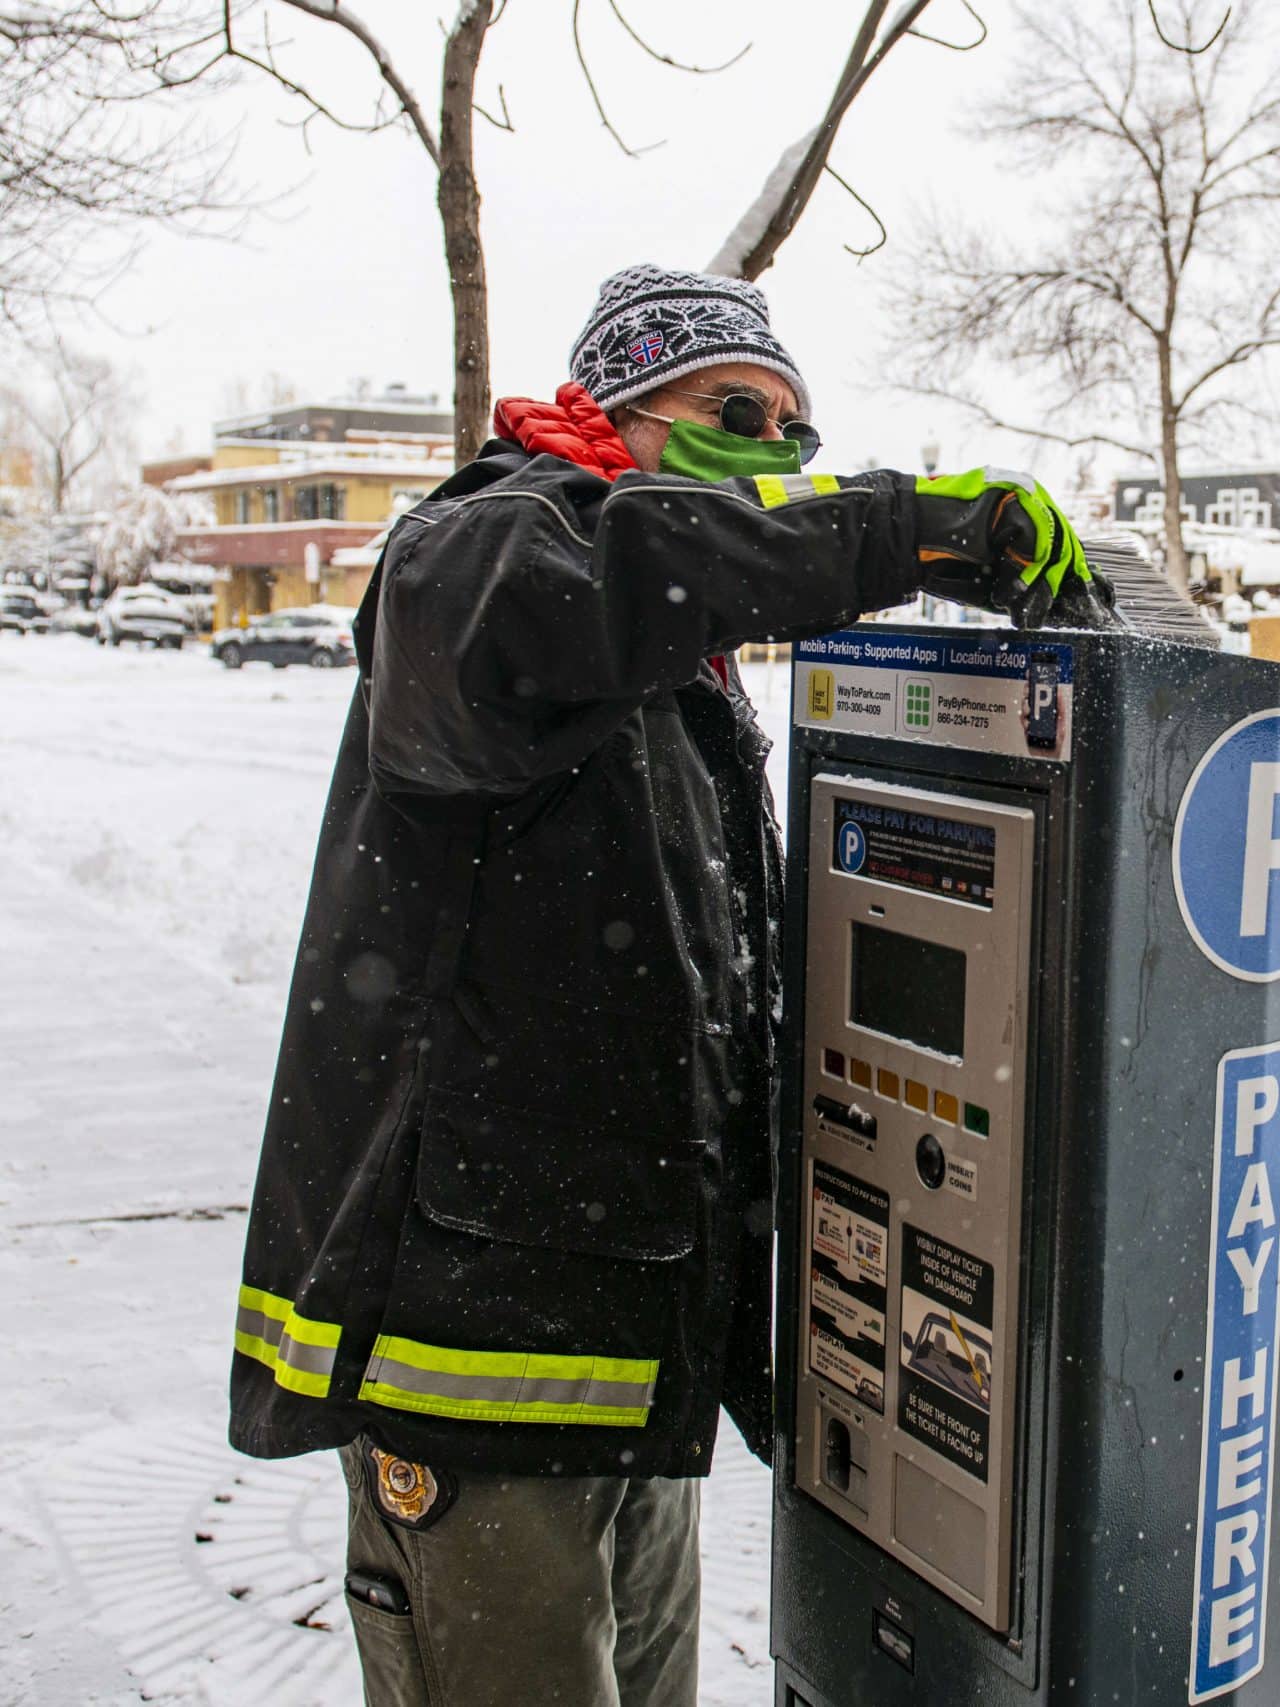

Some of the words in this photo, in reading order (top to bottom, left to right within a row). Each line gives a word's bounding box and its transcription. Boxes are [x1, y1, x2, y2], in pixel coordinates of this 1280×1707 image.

[800, 640, 827, 653] Mobile
[828, 640, 863, 659] Parking:
[864, 642, 912, 661] Supported
[912, 647, 938, 664] Apps
[950, 648, 993, 665] Location
[837, 685, 891, 701] WayToPark.com
[837, 701, 881, 716] 970-300-4009
[937, 696, 1006, 714] PayByPhone.com
[937, 712, 990, 729] 866-234-7275
[840, 803, 882, 825] PLEASE
[884, 810, 906, 830] PAY
[908, 813, 935, 836] FOR
[937, 819, 995, 848] PARKING
[846, 830, 859, 865] P
[947, 1161, 975, 1180] INSERT
[949, 1176, 972, 1193] COINS
[1227, 1076, 1280, 1317] PAY
[921, 1255, 940, 1272] INSIDE
[941, 1264, 950, 1277] OF
[951, 1270, 977, 1291] VEHICLE
[937, 1246, 961, 1266] DISPLAY
[962, 1257, 983, 1276] TICKET
[923, 1272, 934, 1286] ON
[935, 1277, 973, 1305] DASHBOARD
[909, 1392, 917, 1407] BE
[918, 1398, 934, 1416] SURE
[934, 1408, 946, 1425] THE
[947, 1416, 970, 1439] FRONT
[970, 1430, 981, 1445] OF
[905, 1407, 917, 1424] THE
[918, 1415, 939, 1437] TICKET
[946, 1433, 973, 1459] FACING
[974, 1450, 984, 1464] UP
[1208, 1347, 1269, 1669] HERE
